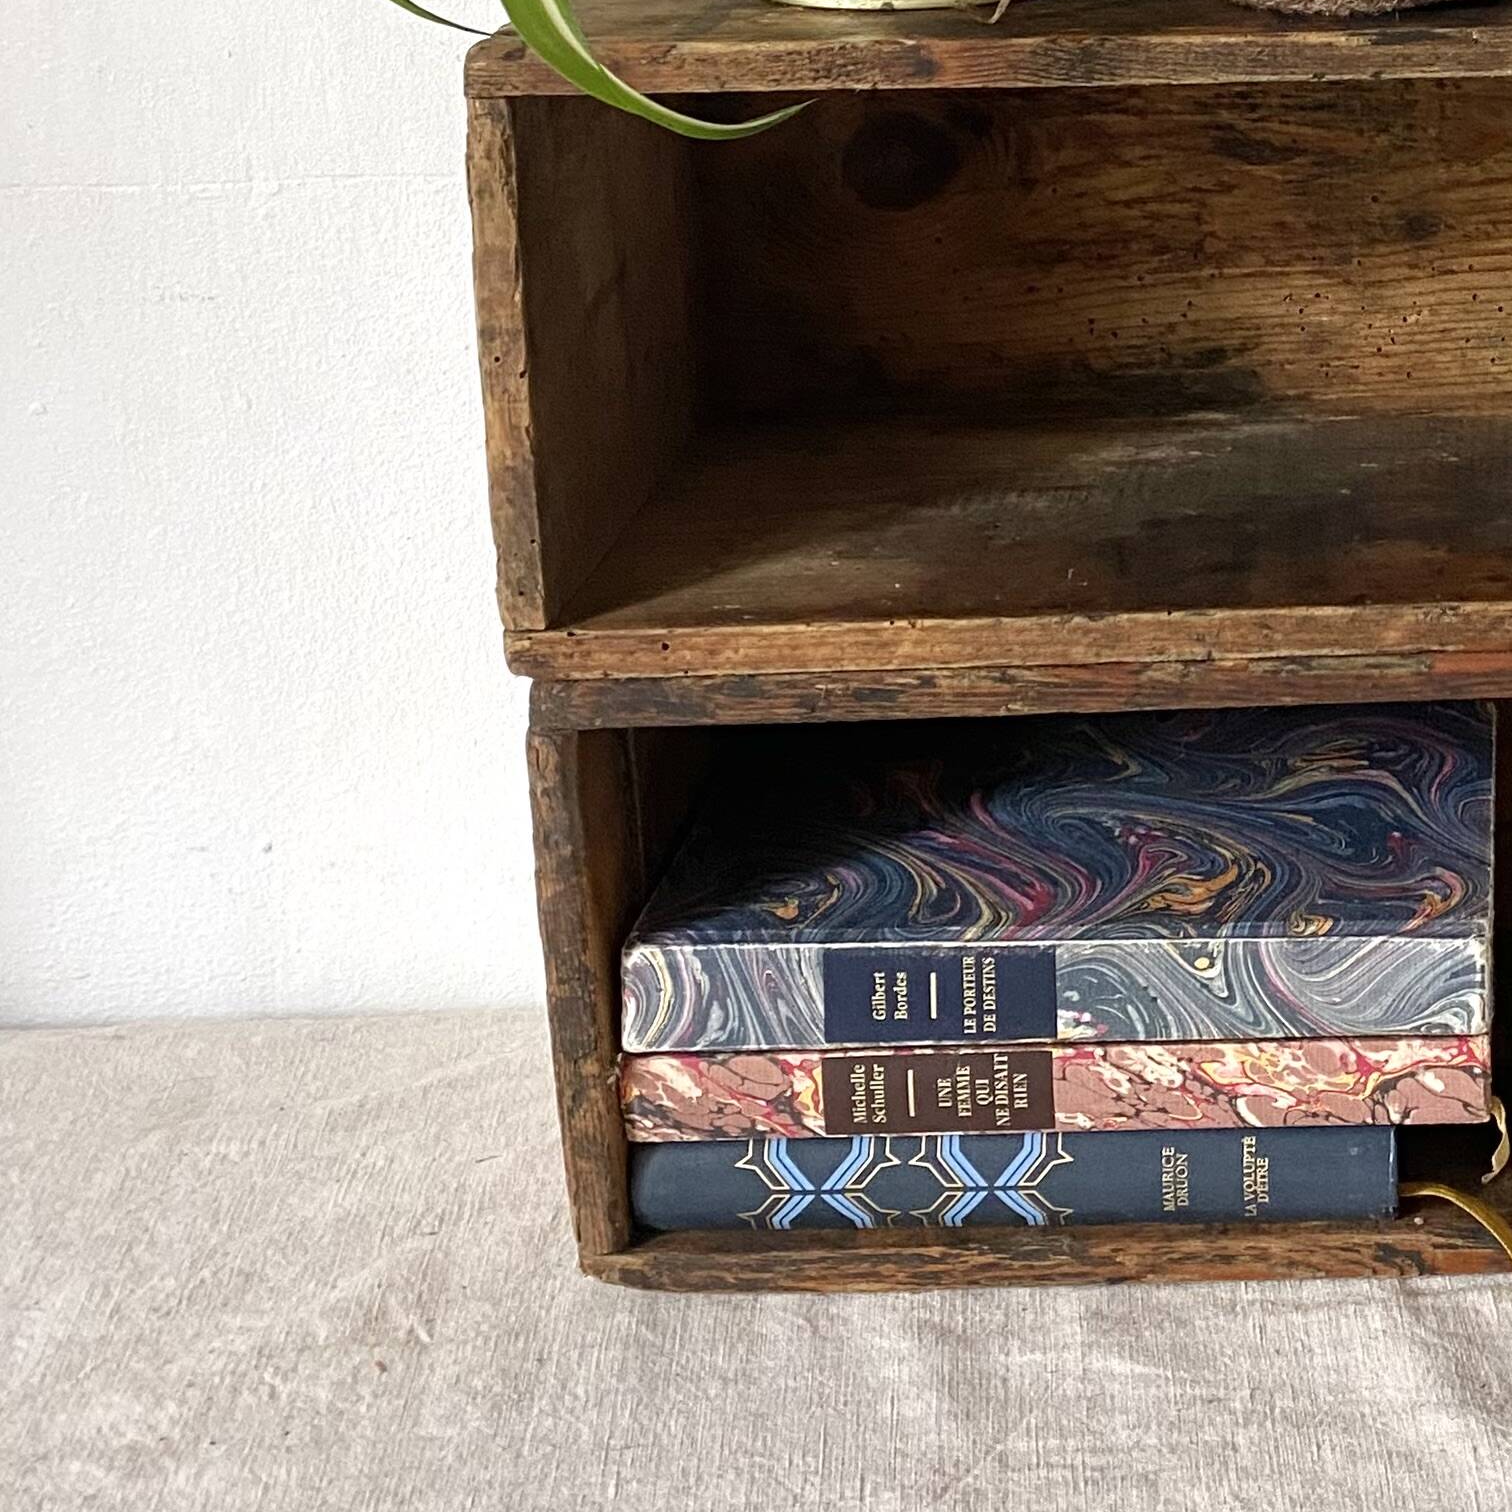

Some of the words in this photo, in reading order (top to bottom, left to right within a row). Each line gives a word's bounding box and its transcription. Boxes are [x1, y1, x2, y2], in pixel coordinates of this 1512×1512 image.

[872, 971, 888, 1021] Gilbert
[892, 971, 909, 1020] Bordes
[962, 955, 977, 1015] PORTEUR
[981, 956, 996, 1010] DESTINS
[963, 1017, 977, 1034] LE
[983, 1013, 997, 1033] DE
[850, 1063, 869, 1124] Michelle
[869, 1063, 887, 1124] Schuller
[936, 1077, 953, 1108] UNE
[955, 1065, 972, 1117] FEMME
[975, 1079, 993, 1106] QUI
[993, 1053, 1010, 1105] DISAIT
[1012, 1072, 1029, 1109] RIEN
[995, 1107, 1011, 1126] NE
[1161, 1146, 1175, 1212] MAURICE
[1175, 1153, 1189, 1207] DRUON
[1241, 1135, 1256, 1201] VOLUPTÉ
[1254, 1157, 1269, 1203] D'ÊTRE
[1244, 1204, 1257, 1217] LA
